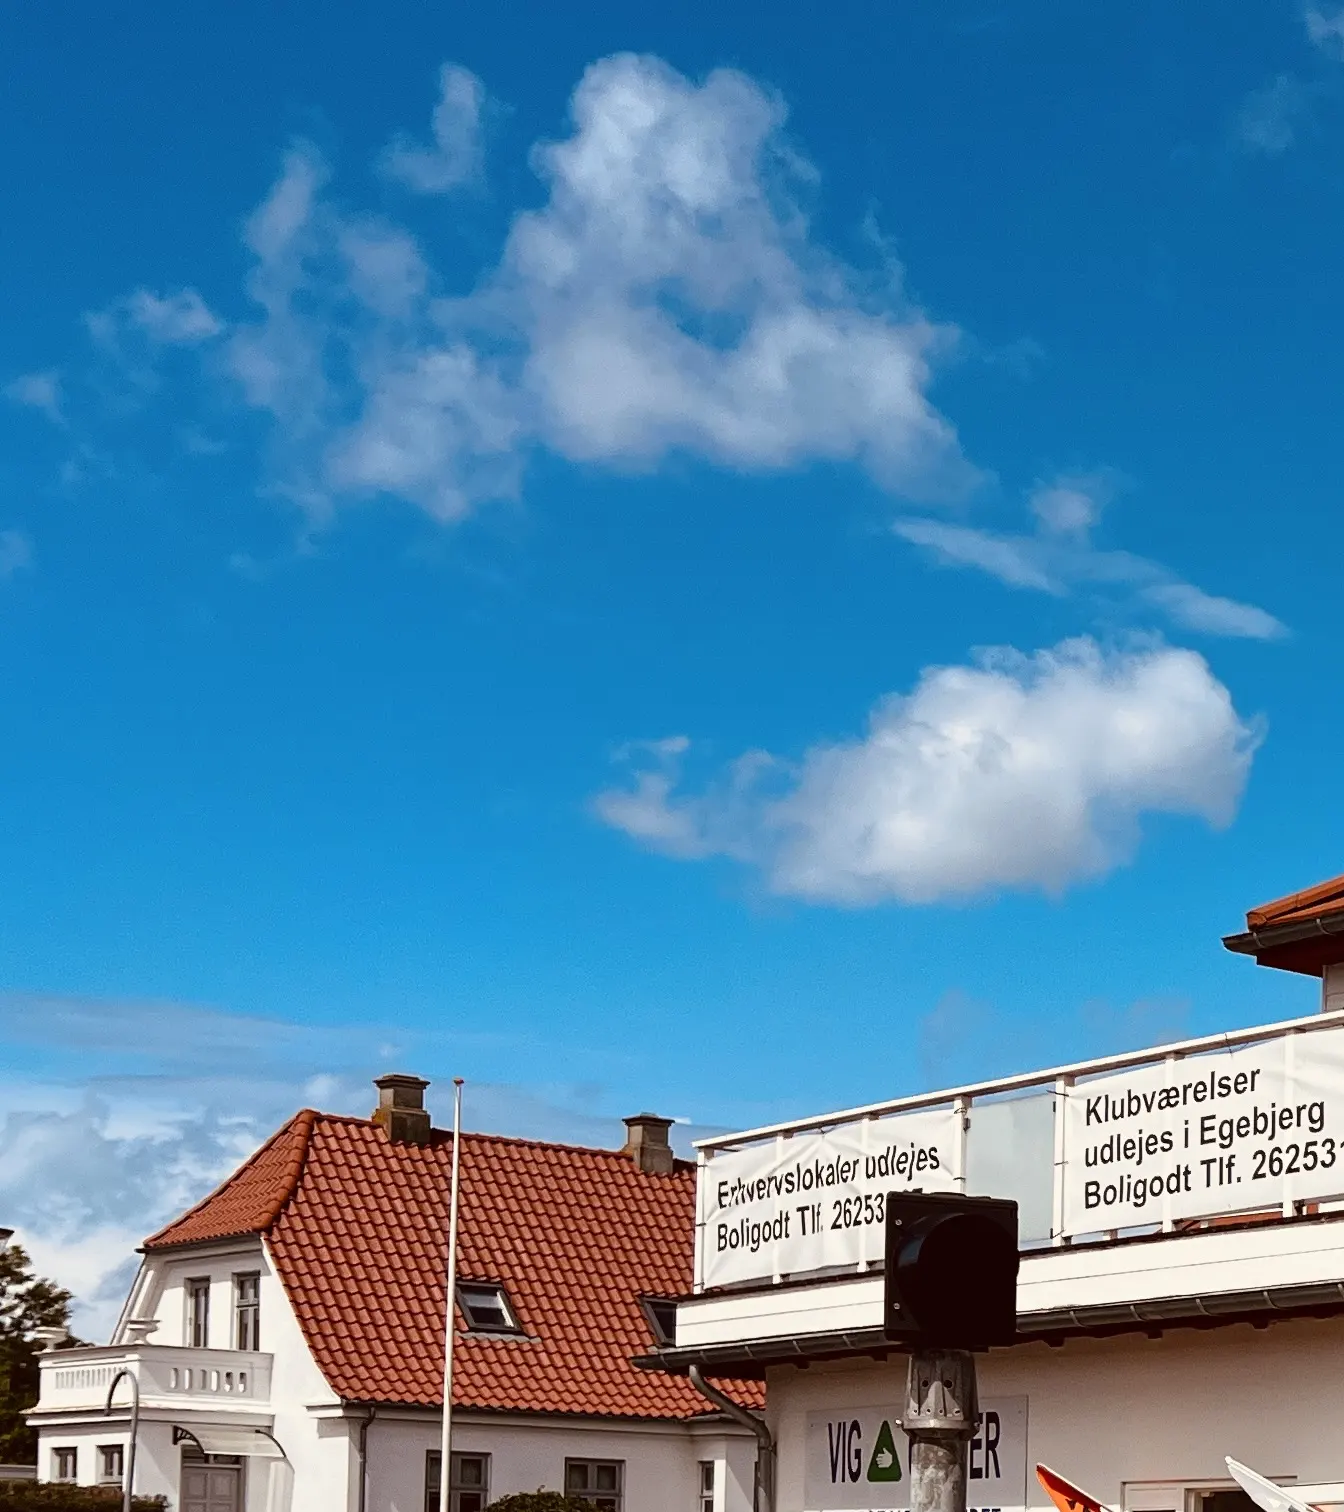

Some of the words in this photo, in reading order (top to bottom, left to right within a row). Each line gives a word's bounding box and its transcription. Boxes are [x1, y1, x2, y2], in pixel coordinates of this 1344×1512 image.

[1086, 1068, 1260, 1126] Klubværelser
[1085, 1129, 1173, 1167] udlejes
[1183, 1120, 1190, 1148] i
[1200, 1101, 1325, 1149] Egebjerg
[718, 1155, 859, 1209] Erhvervslokaler
[865, 1142, 940, 1181] udlejes
[1085, 1164, 1191, 1209] Boligodt
[1200, 1155, 1242, 1188] Tlf.
[717, 1210, 790, 1252] Boligodt
[827, 1419, 862, 1483] VIG
